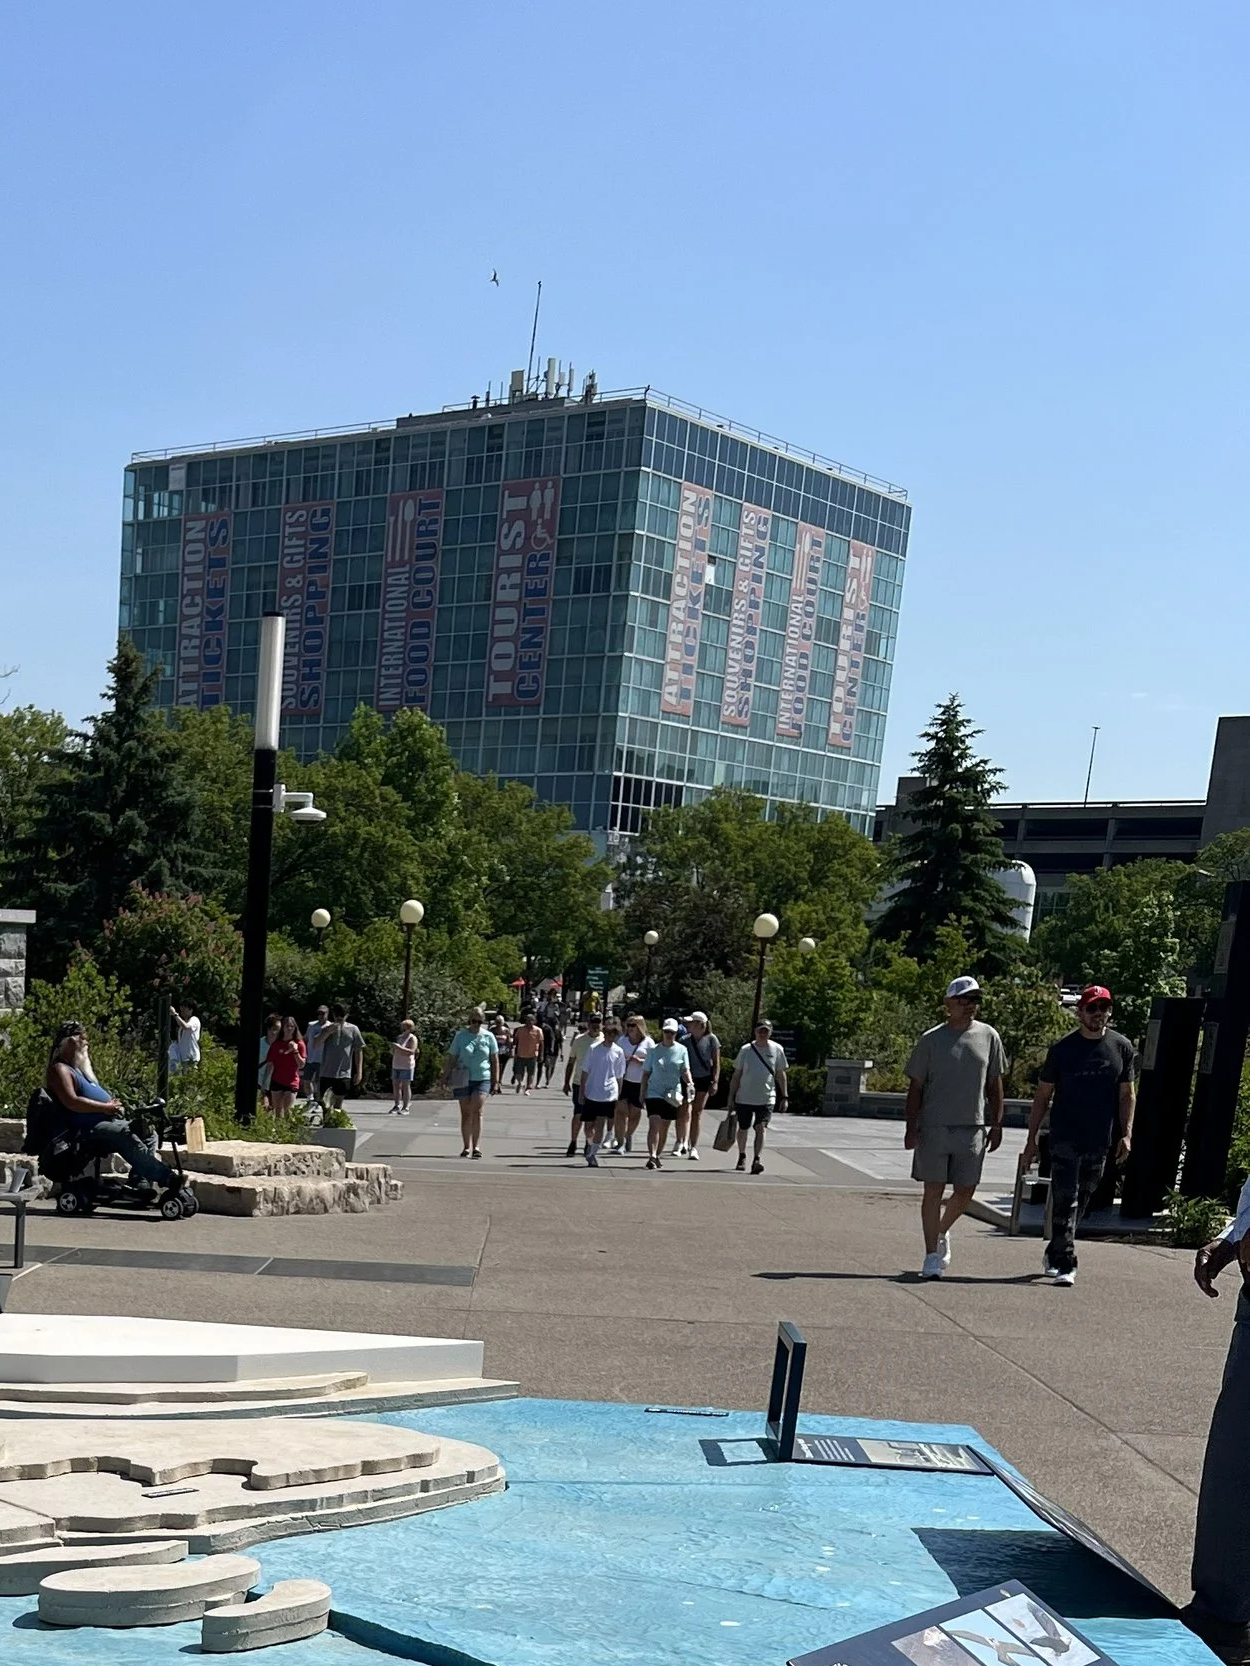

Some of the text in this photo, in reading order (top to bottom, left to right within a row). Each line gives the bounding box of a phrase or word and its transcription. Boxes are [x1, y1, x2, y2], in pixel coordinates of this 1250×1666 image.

[178, 520, 205, 706] ATTRACTION
[202, 517, 228, 707] TICKETS
[281, 509, 306, 709] SOUVENIRS & GIFTS
[298, 505, 333, 711] SHOPPING
[377, 564, 410, 707] INTERNATIONAL
[402, 497, 442, 705] FOOD COURT
[487, 490, 527, 702] TOURIST
[514, 551, 550, 701] CENTER
[664, 489, 697, 707] ATTRACTION
[679, 495, 711, 703] TICKETS
[724, 510, 756, 718] SOUVENIRS & GIFTS
[738, 513, 770, 719] SHOPPING
[777, 594, 804, 730] INTERNATIONAL
[791, 536, 823, 732] FOOD COURT
[831, 549, 860, 735] TOURIST
[841, 611, 867, 742] CENTER
